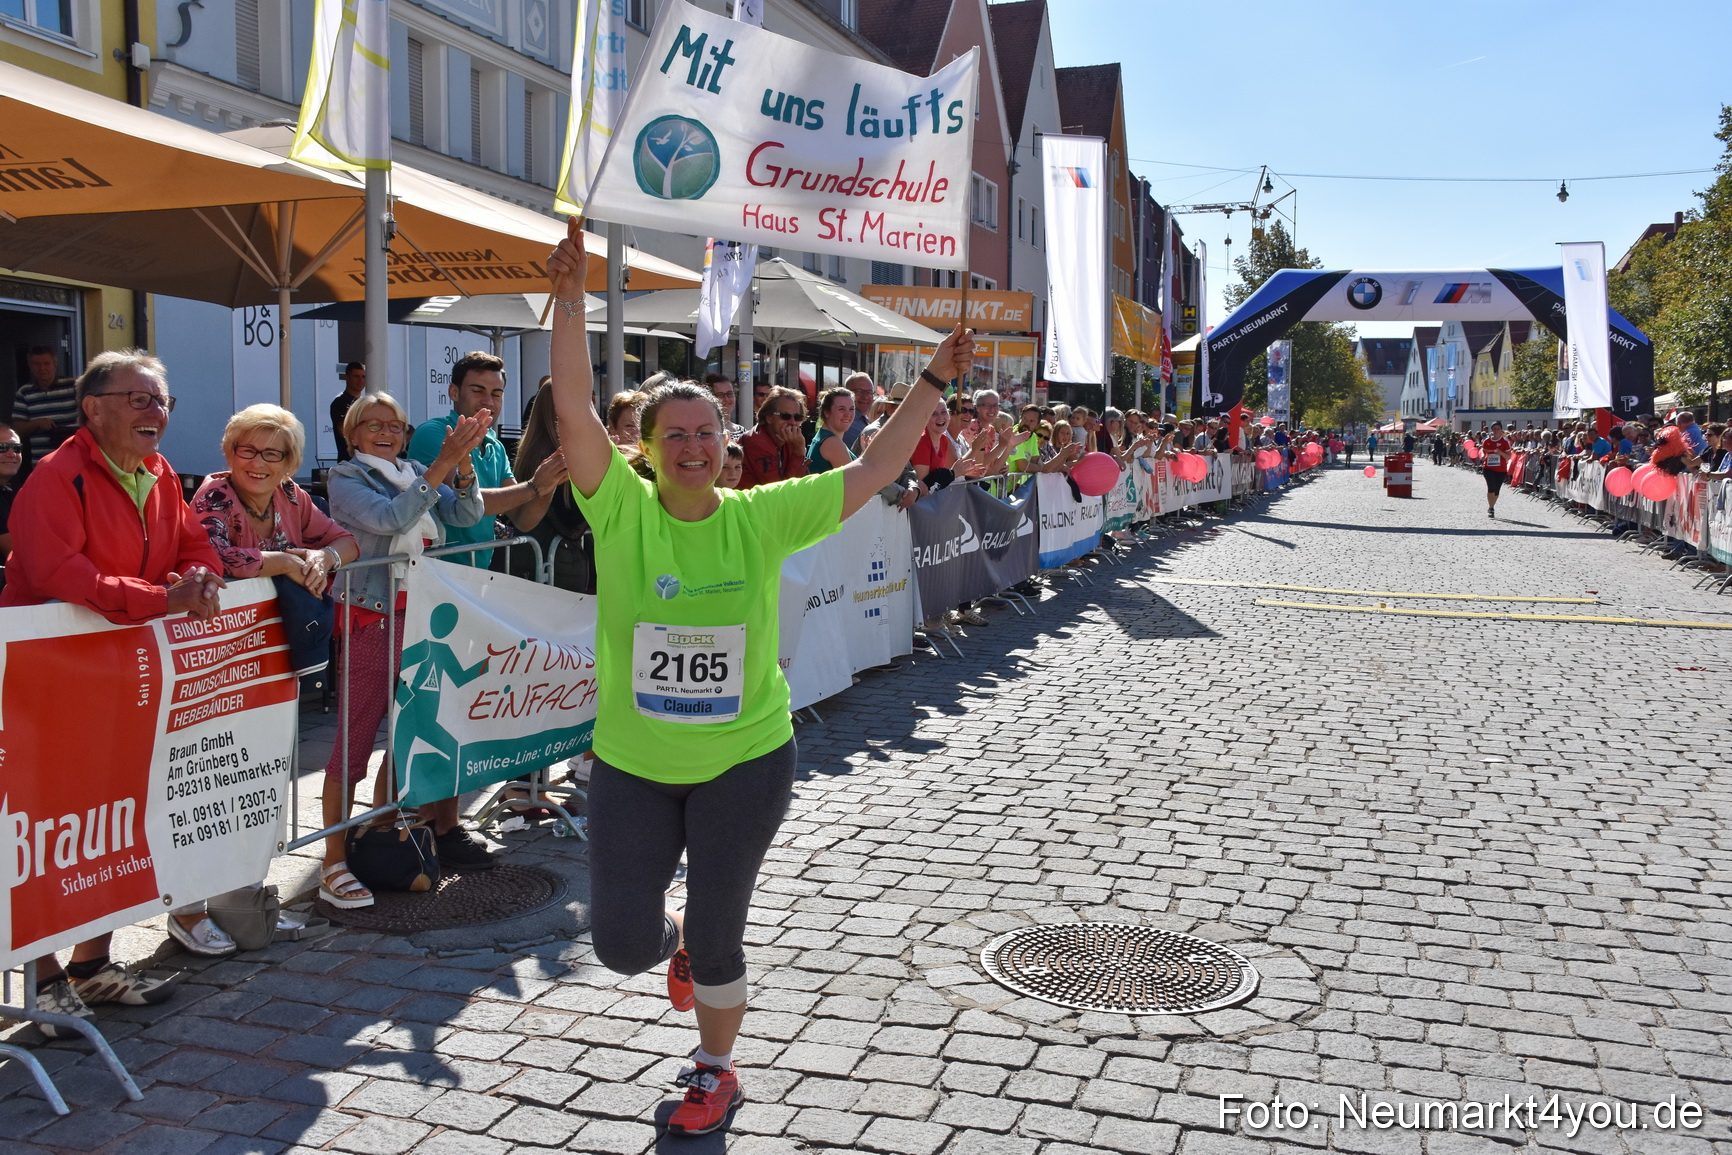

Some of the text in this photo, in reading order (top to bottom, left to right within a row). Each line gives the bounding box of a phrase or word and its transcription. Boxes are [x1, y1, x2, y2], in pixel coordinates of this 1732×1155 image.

[660, 24, 735, 95] Mit
[761, 83, 964, 138] uns läufts
[746, 141, 949, 204] Grundschule
[743, 204, 956, 256] Haus St. Marien
[109, 312, 125, 329] 24
[1212, 303, 1289, 352] PARTL NEUMARKT
[172, 608, 258, 640] BINDESTRICKE
[667, 633, 715, 645] BOCK
[137, 648, 149, 707] Seit 1929
[180, 661, 260, 699] RUNDSCHLINGEN
[649, 651, 729, 682] 2165
[656, 685, 712, 694] PARTL Neumarkt
[663, 699, 713, 713] Claudia
[174, 693, 244, 728] HEBEBÄNDER
[169, 731, 235, 762] Braun GmbH
[466, 748, 542, 776] Service-Line:
[167, 747, 249, 781] Am Grünberg 8
[167, 776, 212, 801] D-92318
[169, 809, 191, 829] Tel.
[193, 800, 227, 823] 09181
[239, 787, 277, 810] 2307-0
[8, 797, 136, 888] Braun
[172, 829, 195, 849] Fax
[197, 819, 232, 842] 09181
[61, 855, 153, 896] Sicher ist sicher
